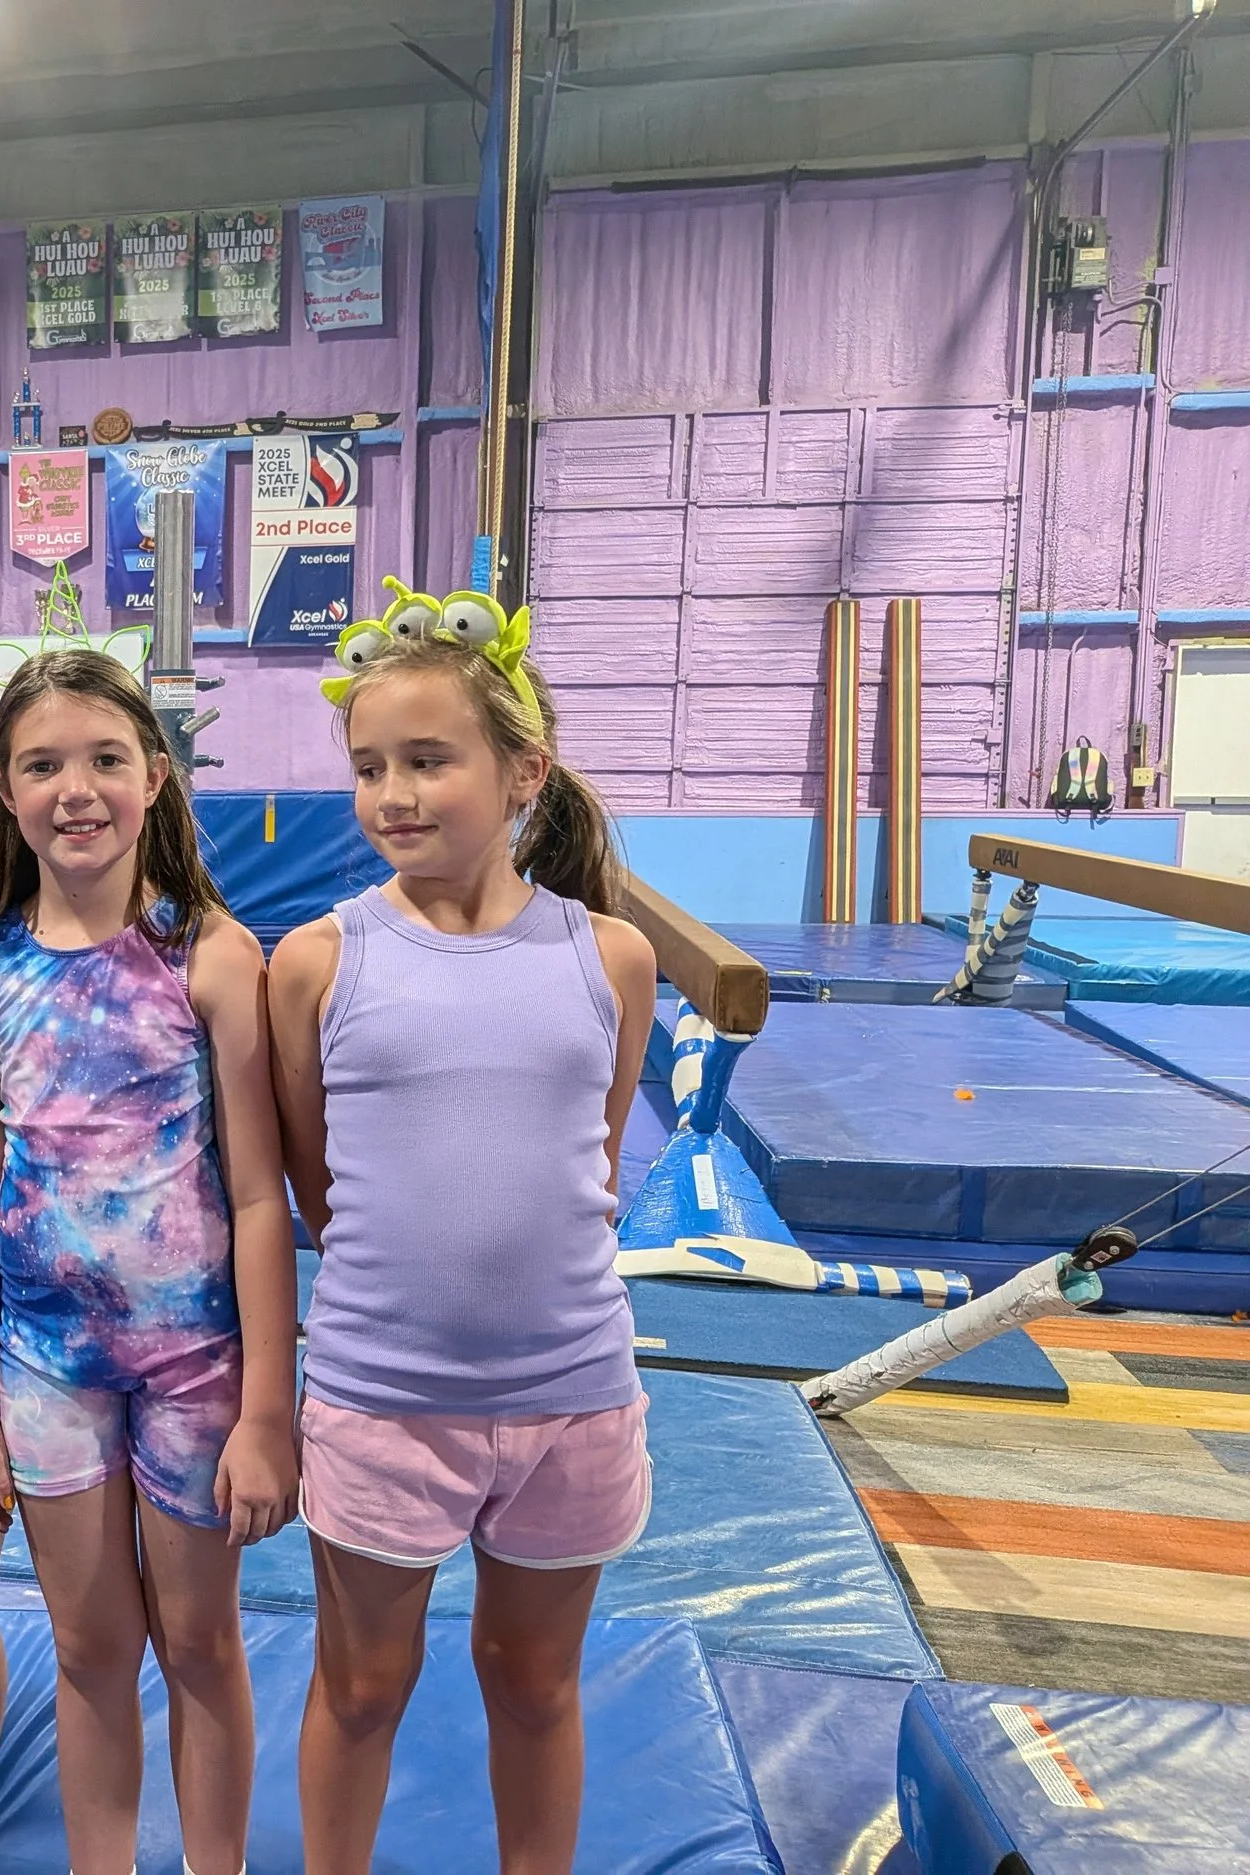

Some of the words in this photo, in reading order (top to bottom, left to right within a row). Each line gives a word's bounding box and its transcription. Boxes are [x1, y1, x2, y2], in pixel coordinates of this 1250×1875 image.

[151, 224, 159, 235] A
[237, 218, 245, 229] A
[62, 230, 70, 243] A
[207, 231, 235, 248] HUI
[241, 228, 275, 246] HOU
[122, 237, 148, 254] HUI
[155, 235, 188, 252] HOU
[35, 245, 62, 262] HUI
[66, 242, 99, 260] HOU
[219, 246, 262, 264] LUAU
[134, 252, 175, 270] LUAU
[46, 259, 87, 277] LUAU
[138, 280, 169, 292] 2025
[224, 273, 255, 286] 2025
[52, 286, 82, 299] 2025
[233, 288, 268, 300] PLACE
[304, 290, 344, 306] Second
[60, 300, 94, 312] PLACE
[68, 311, 96, 324] GOLD
[126, 451, 164, 470] Snow
[166, 445, 207, 467] Globe
[258, 449, 290, 460] 2025
[258, 461, 293, 473] XCEL
[141, 468, 190, 487] Classic
[258, 473, 299, 486] STATE
[258, 486, 296, 498] MEET
[256, 520, 291, 536] 2nd
[297, 519, 352, 535] Place
[16, 535, 35, 546] 3RD
[36, 532, 82, 545] PLACE
[138, 557, 154, 568] XC
[300, 554, 323, 564] Xcel
[324, 553, 350, 563] Gold
[290, 609, 327, 623] Xcel
[305, 623, 347, 631] Gymnastics
